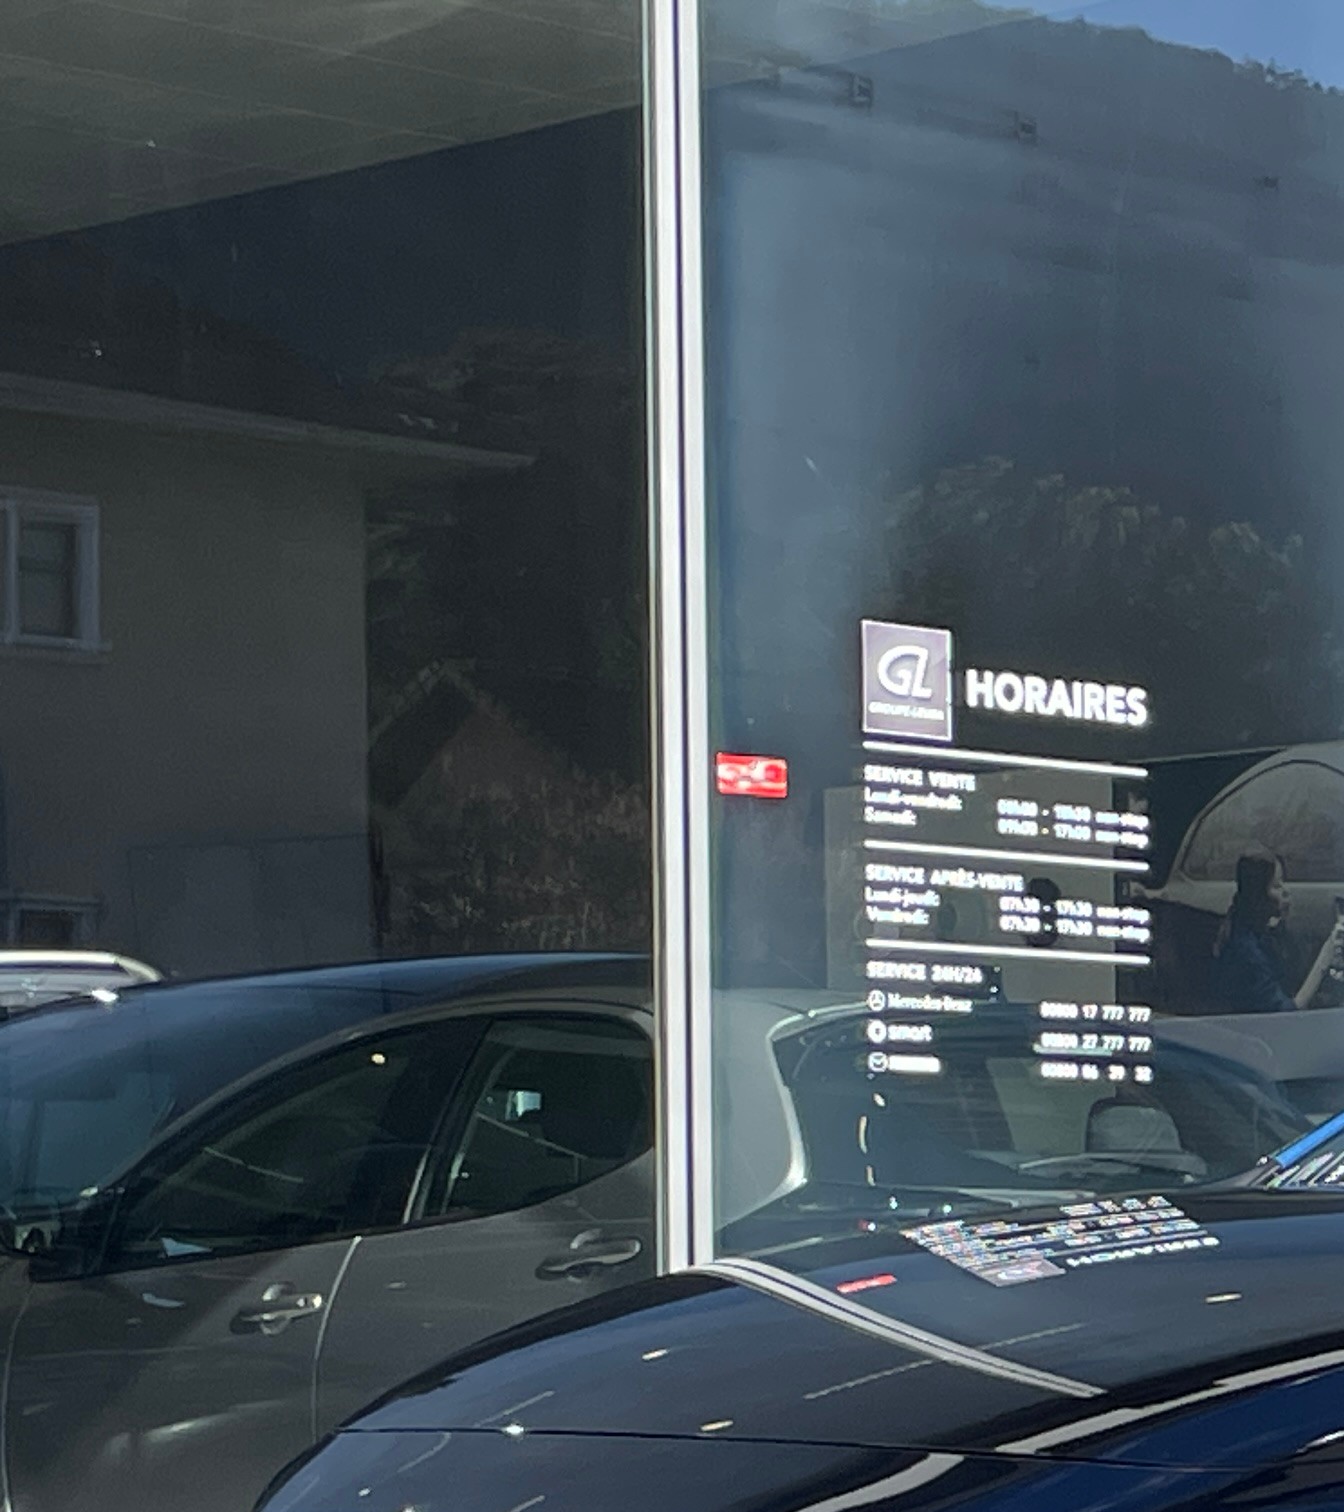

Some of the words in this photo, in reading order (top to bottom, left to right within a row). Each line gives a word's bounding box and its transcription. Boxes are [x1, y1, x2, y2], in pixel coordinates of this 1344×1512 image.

[877, 645, 932, 699] GL
[965, 668, 1149, 727] HORAIRES
[864, 765, 923, 786] SERVICE
[928, 771, 975, 791] VENTE
[865, 864, 925, 885] SERVICE
[929, 867, 1024, 892] APRÈS-VENTE
[866, 960, 926, 980] SERVICE
[887, 991, 973, 1013] Mercedes-Benz
[1101, 1005, 1125, 1020] 777
[1128, 1006, 1152, 1022] 777
[888, 1024, 932, 1041] smart
[1101, 1034, 1125, 1050] 777
[1128, 1035, 1152, 1052] 777
